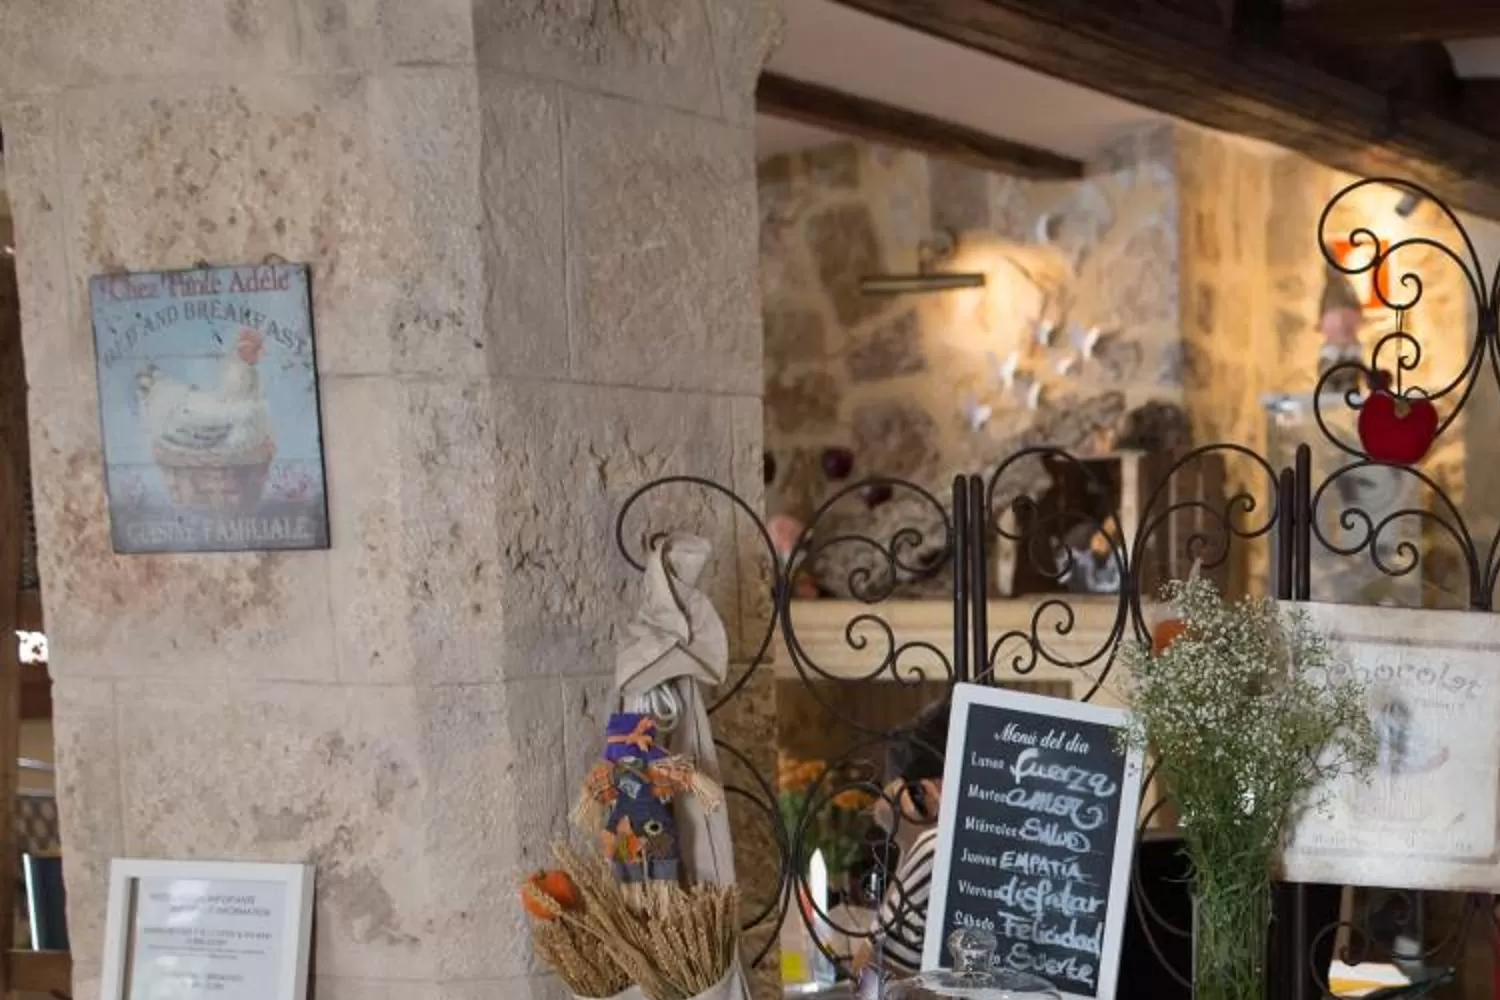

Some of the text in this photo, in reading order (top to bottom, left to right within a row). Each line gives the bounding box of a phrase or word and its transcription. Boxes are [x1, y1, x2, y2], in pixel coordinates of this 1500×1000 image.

[183, 298, 307, 354] BREAKFAST
[202, 515, 315, 543] FAMILIALE
[1039, 728, 1067, 751] del
[971, 751, 1004, 770] Lunes
[960, 847, 998, 868] Jueves
